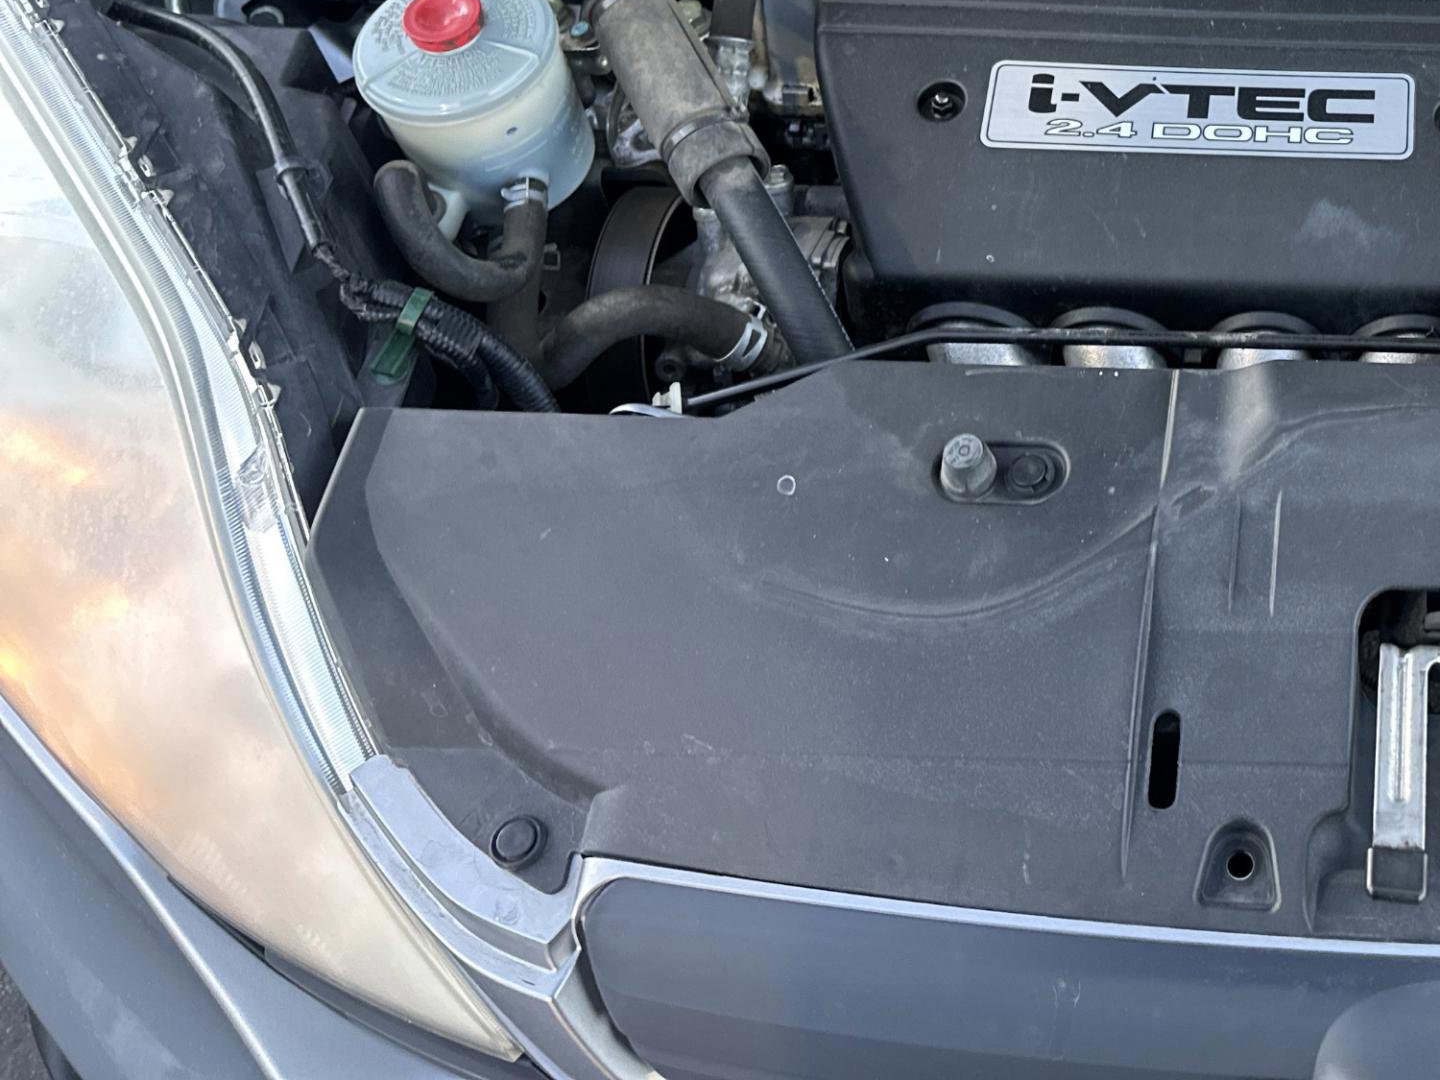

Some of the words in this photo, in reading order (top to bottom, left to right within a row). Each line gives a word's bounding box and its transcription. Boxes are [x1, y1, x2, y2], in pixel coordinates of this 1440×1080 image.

[1028, 73, 1376, 124] i-VTEC
[1044, 118, 1138, 139] 2.4
[1151, 123, 1354, 145] DOHC
